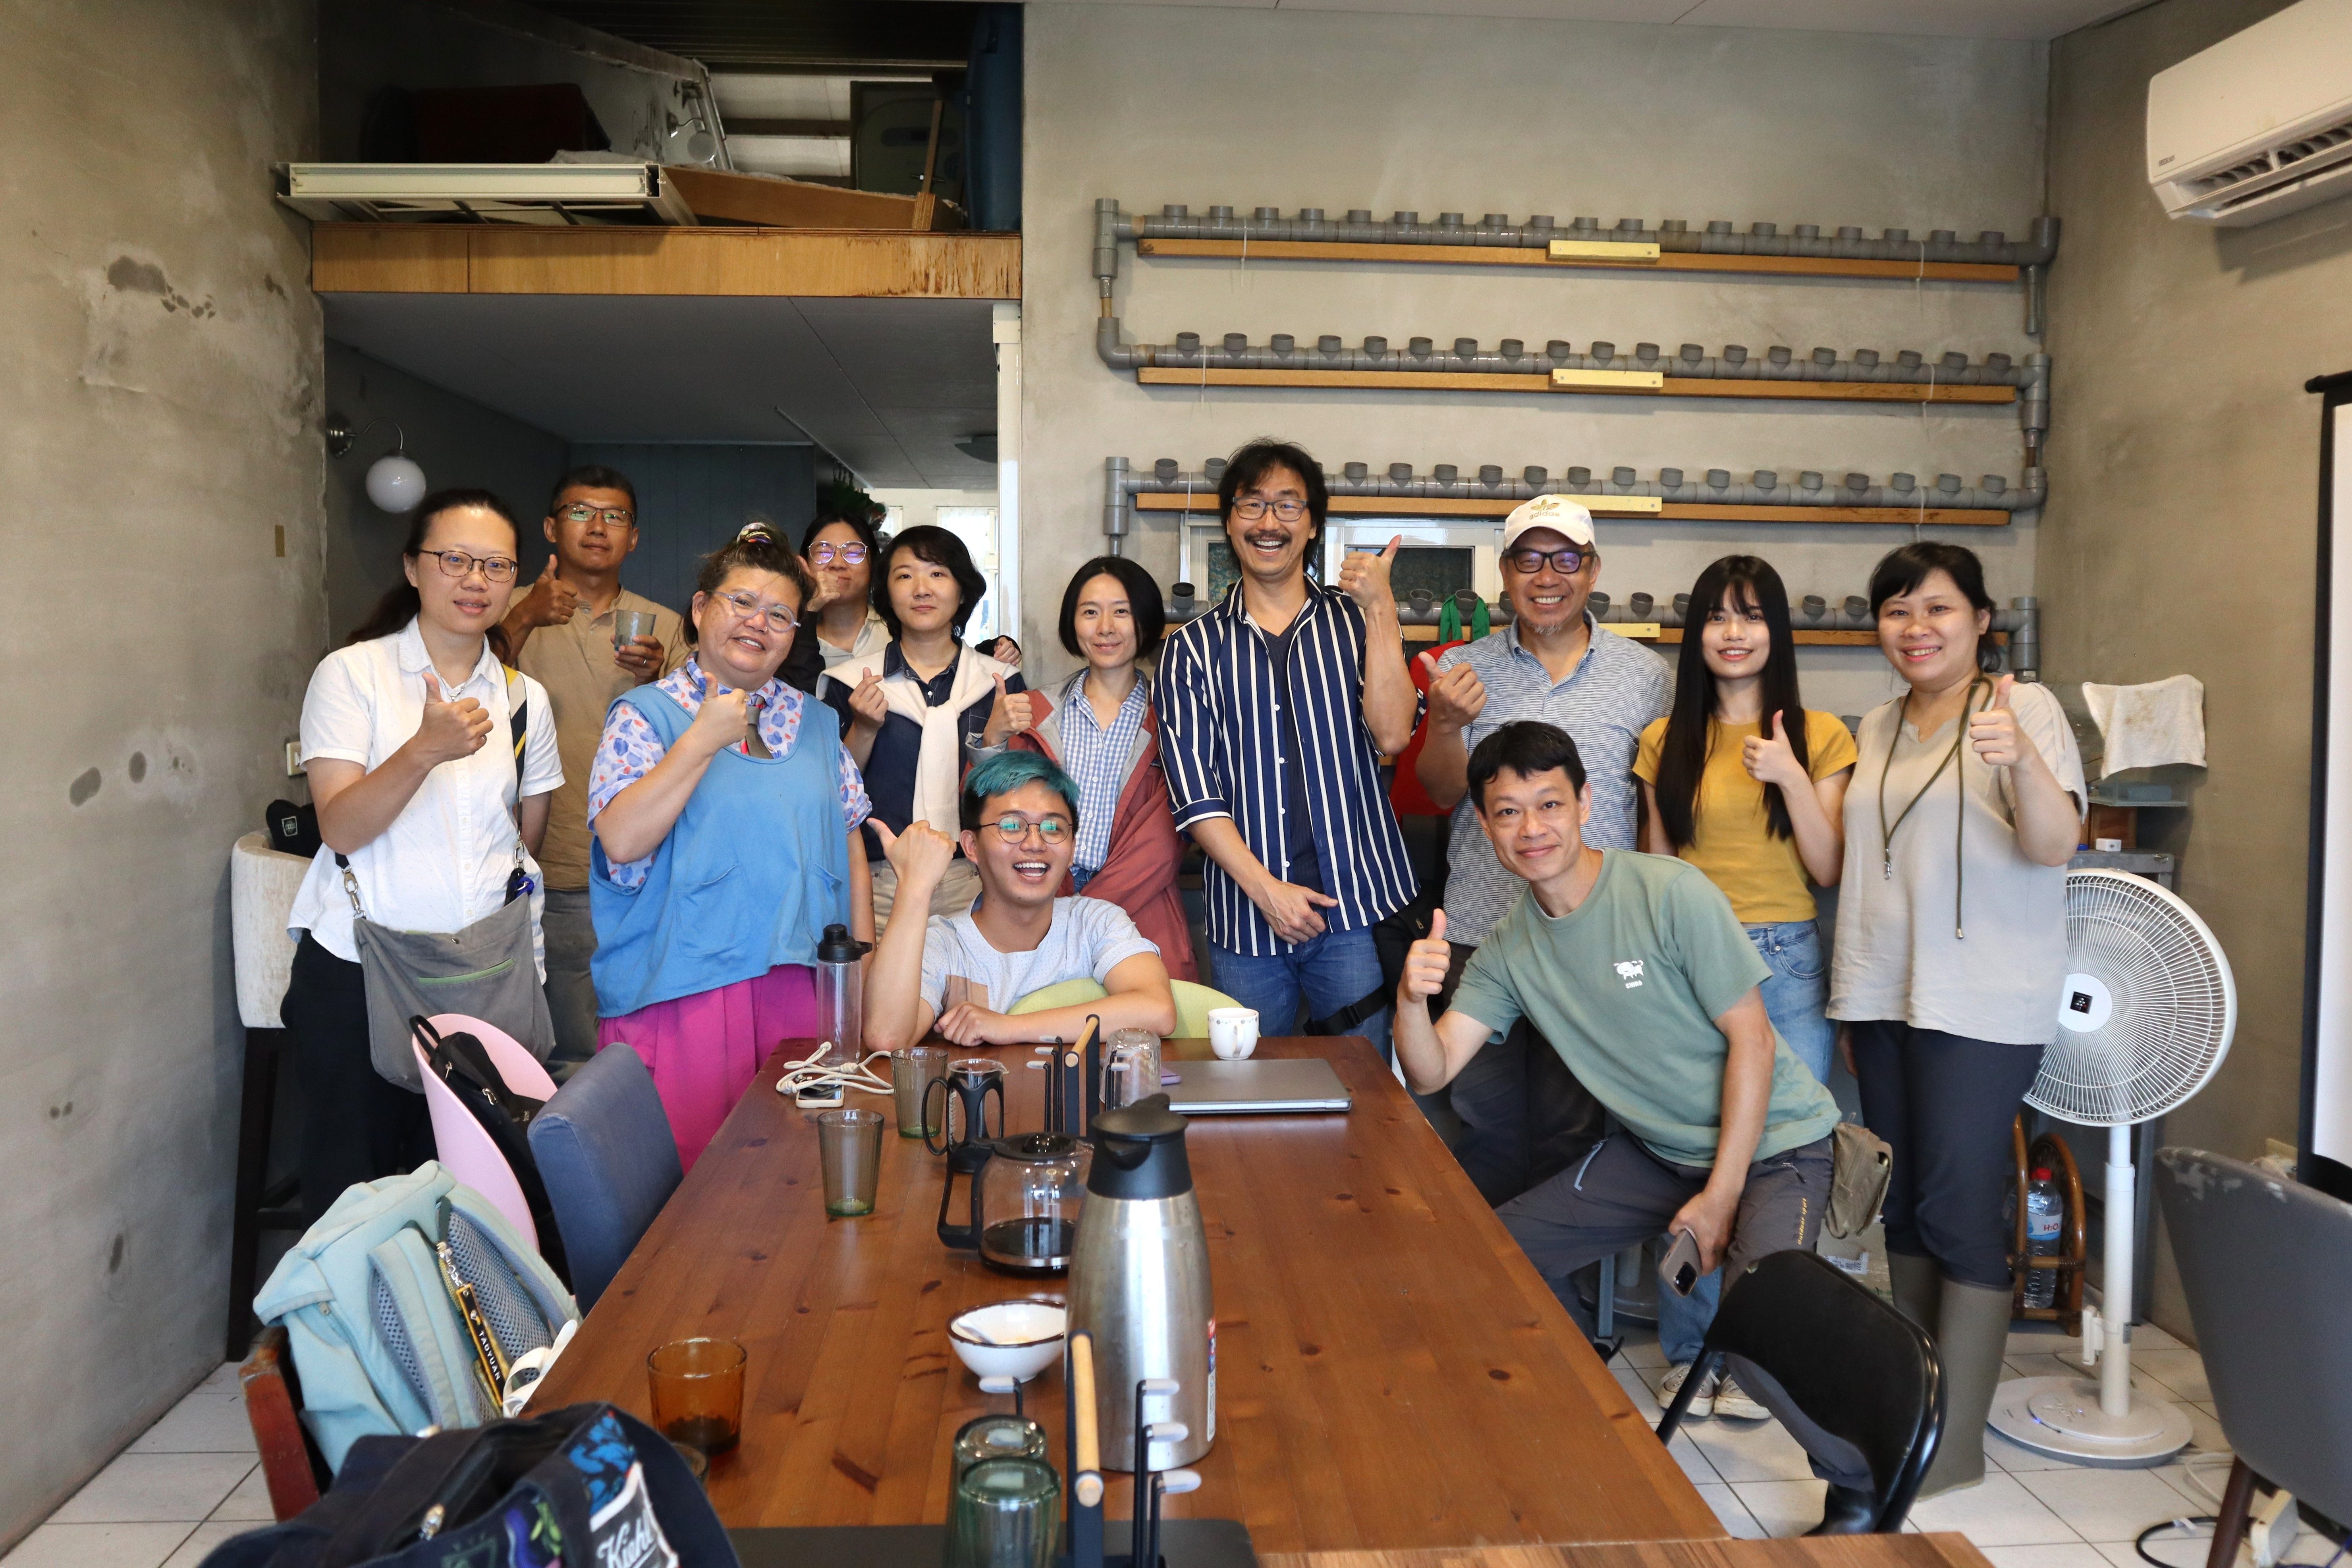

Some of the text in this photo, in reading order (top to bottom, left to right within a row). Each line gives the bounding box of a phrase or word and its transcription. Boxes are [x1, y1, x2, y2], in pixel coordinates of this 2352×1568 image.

[1529, 511, 1560, 520] adidas
[1625, 980, 1643, 989] SHIRO
[479, 1330, 501, 1381] TAOYUAN
